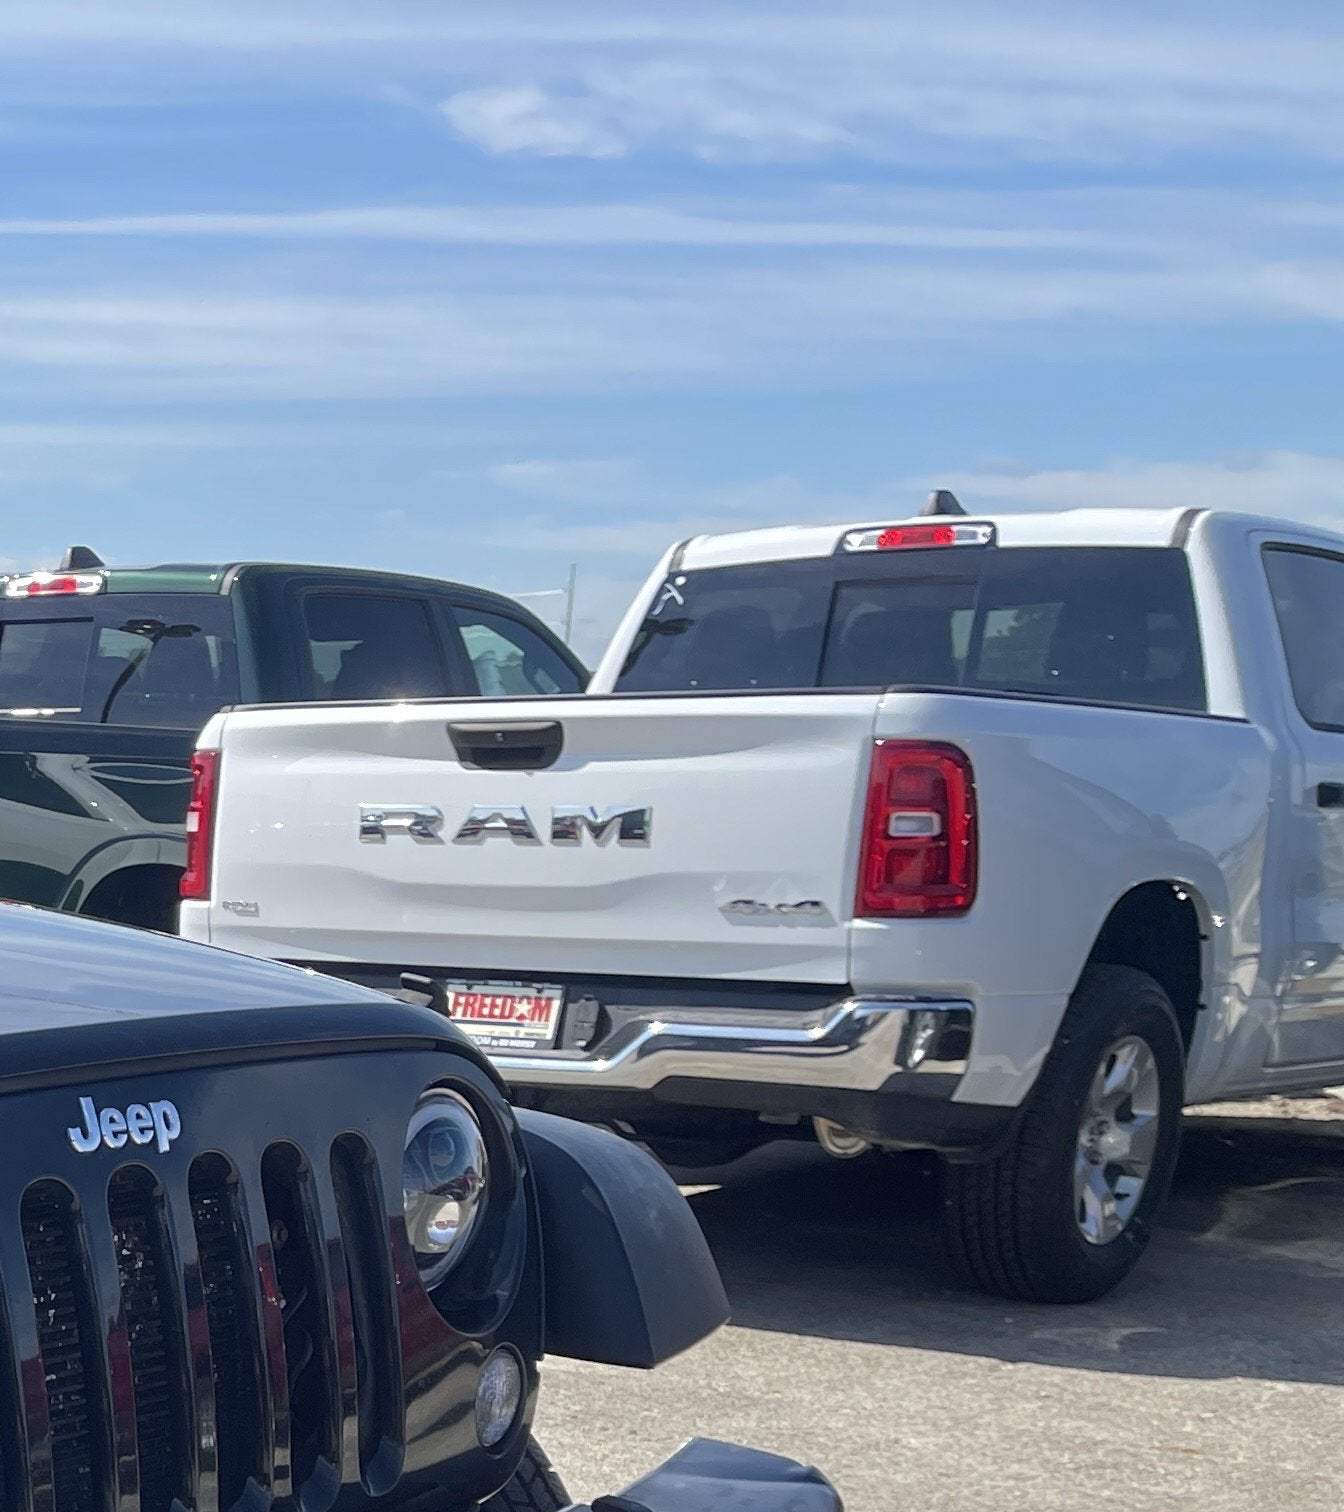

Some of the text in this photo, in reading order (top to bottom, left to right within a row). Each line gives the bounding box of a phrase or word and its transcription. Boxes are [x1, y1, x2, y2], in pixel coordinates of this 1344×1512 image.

[359, 802, 653, 848] RAM
[451, 991, 554, 1023] FREEDOM
[66, 1096, 181, 1154] Jeep
